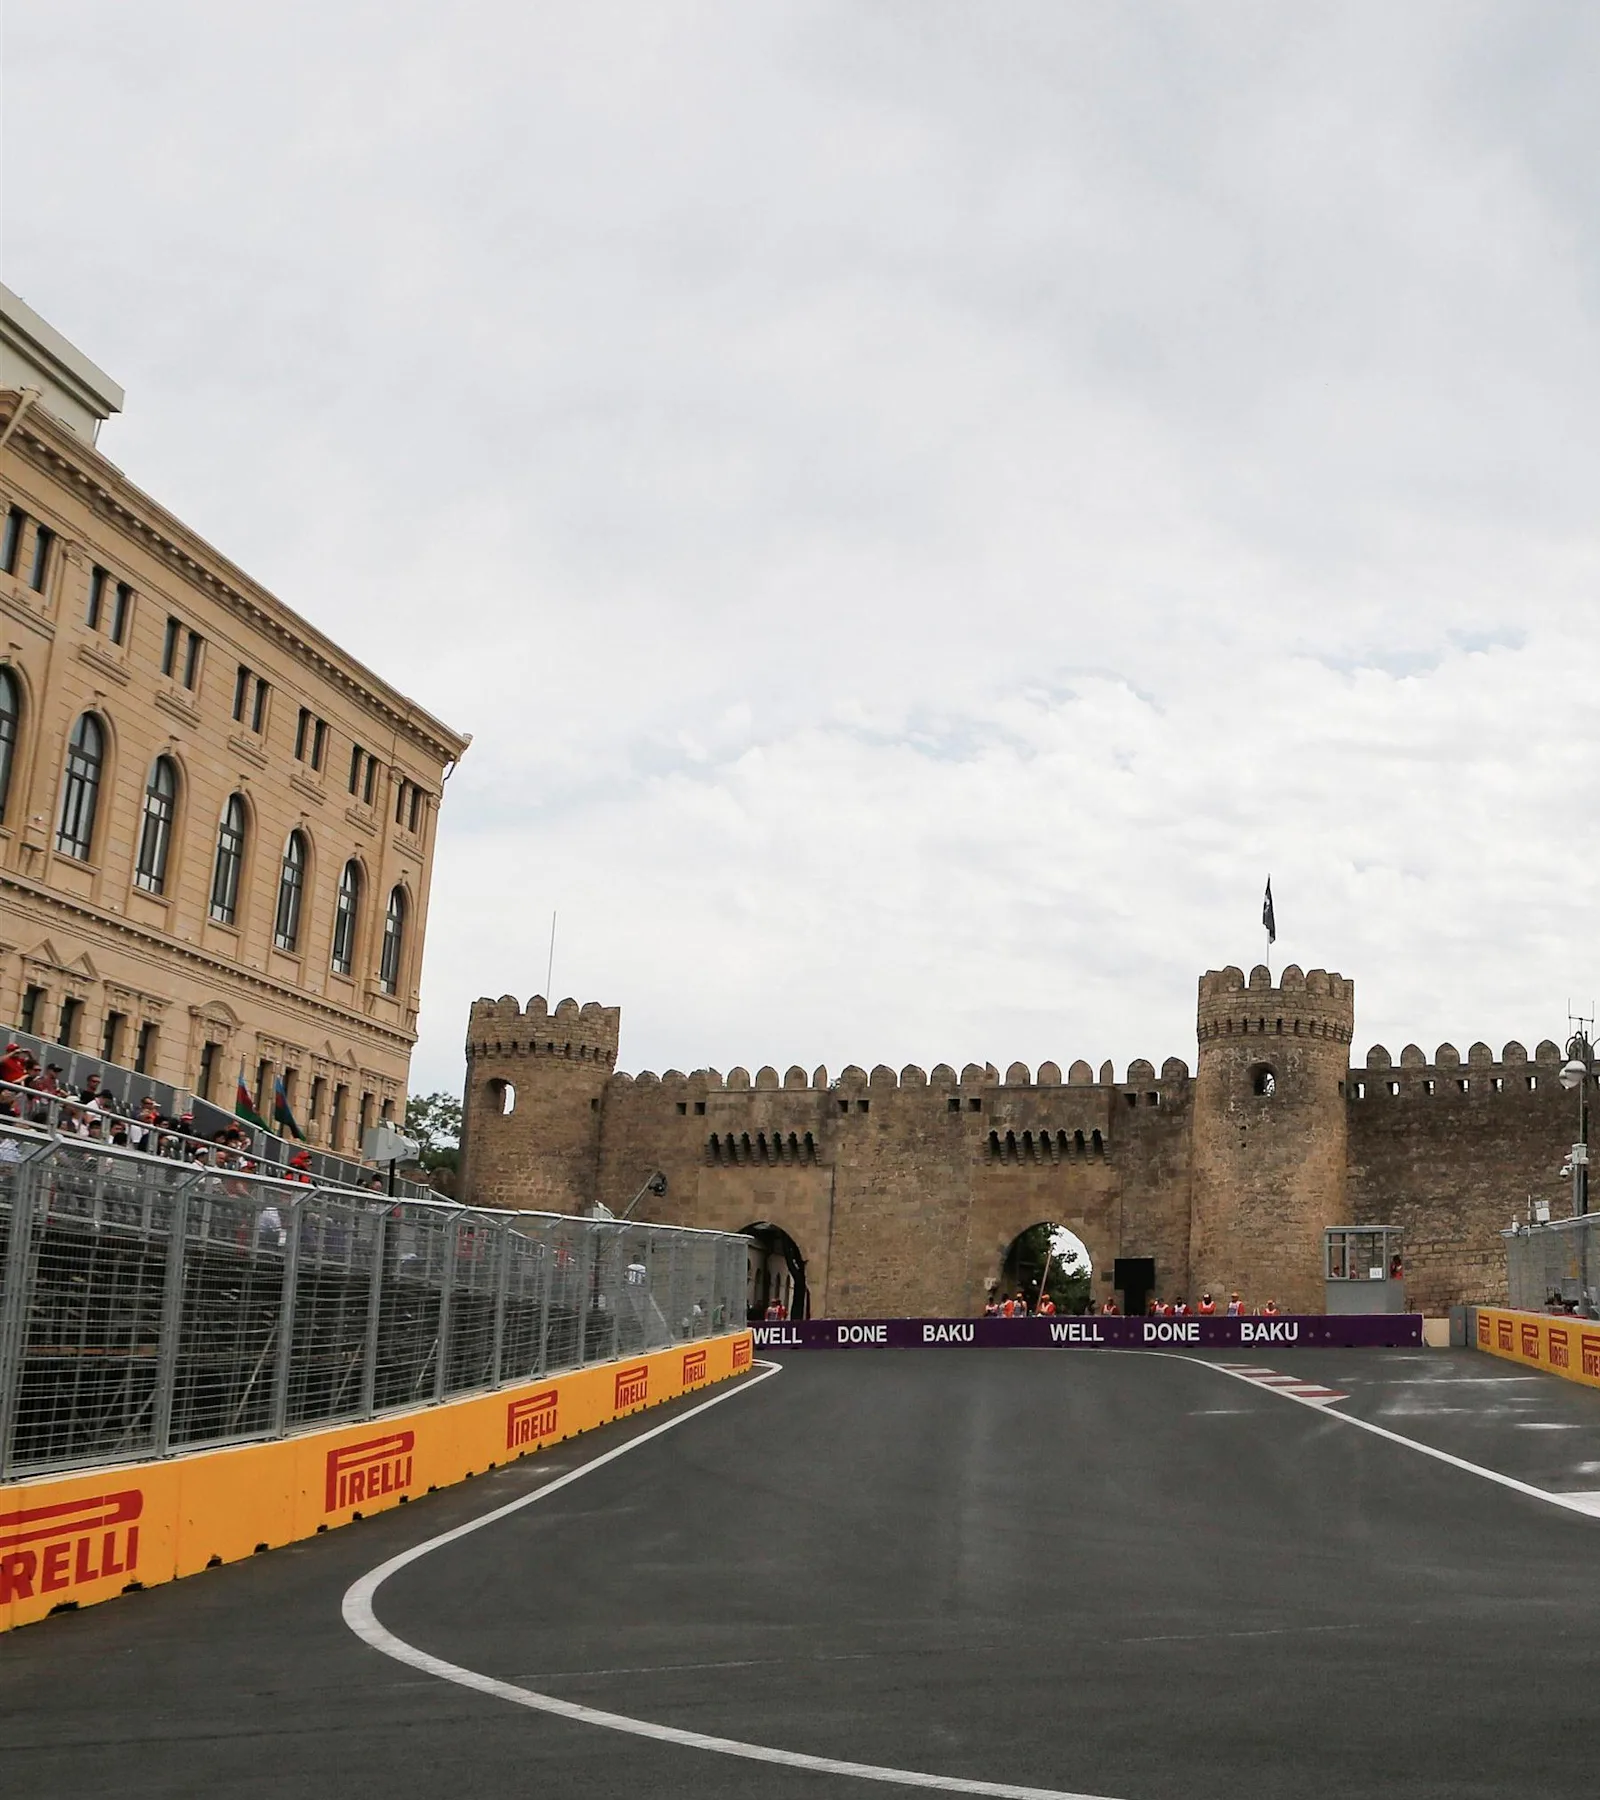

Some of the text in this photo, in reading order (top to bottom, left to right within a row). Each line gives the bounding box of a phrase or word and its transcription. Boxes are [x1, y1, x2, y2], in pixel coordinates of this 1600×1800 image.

[753, 1322, 1298, 1345] WELL DONE BAKU WELL DONE BAKU
[615, 1365, 648, 1410] PIRELLI
[683, 1350, 706, 1385] PIRELLI
[507, 1389, 558, 1449] PIRELLI
[325, 1431, 415, 1513] PIRELLI
